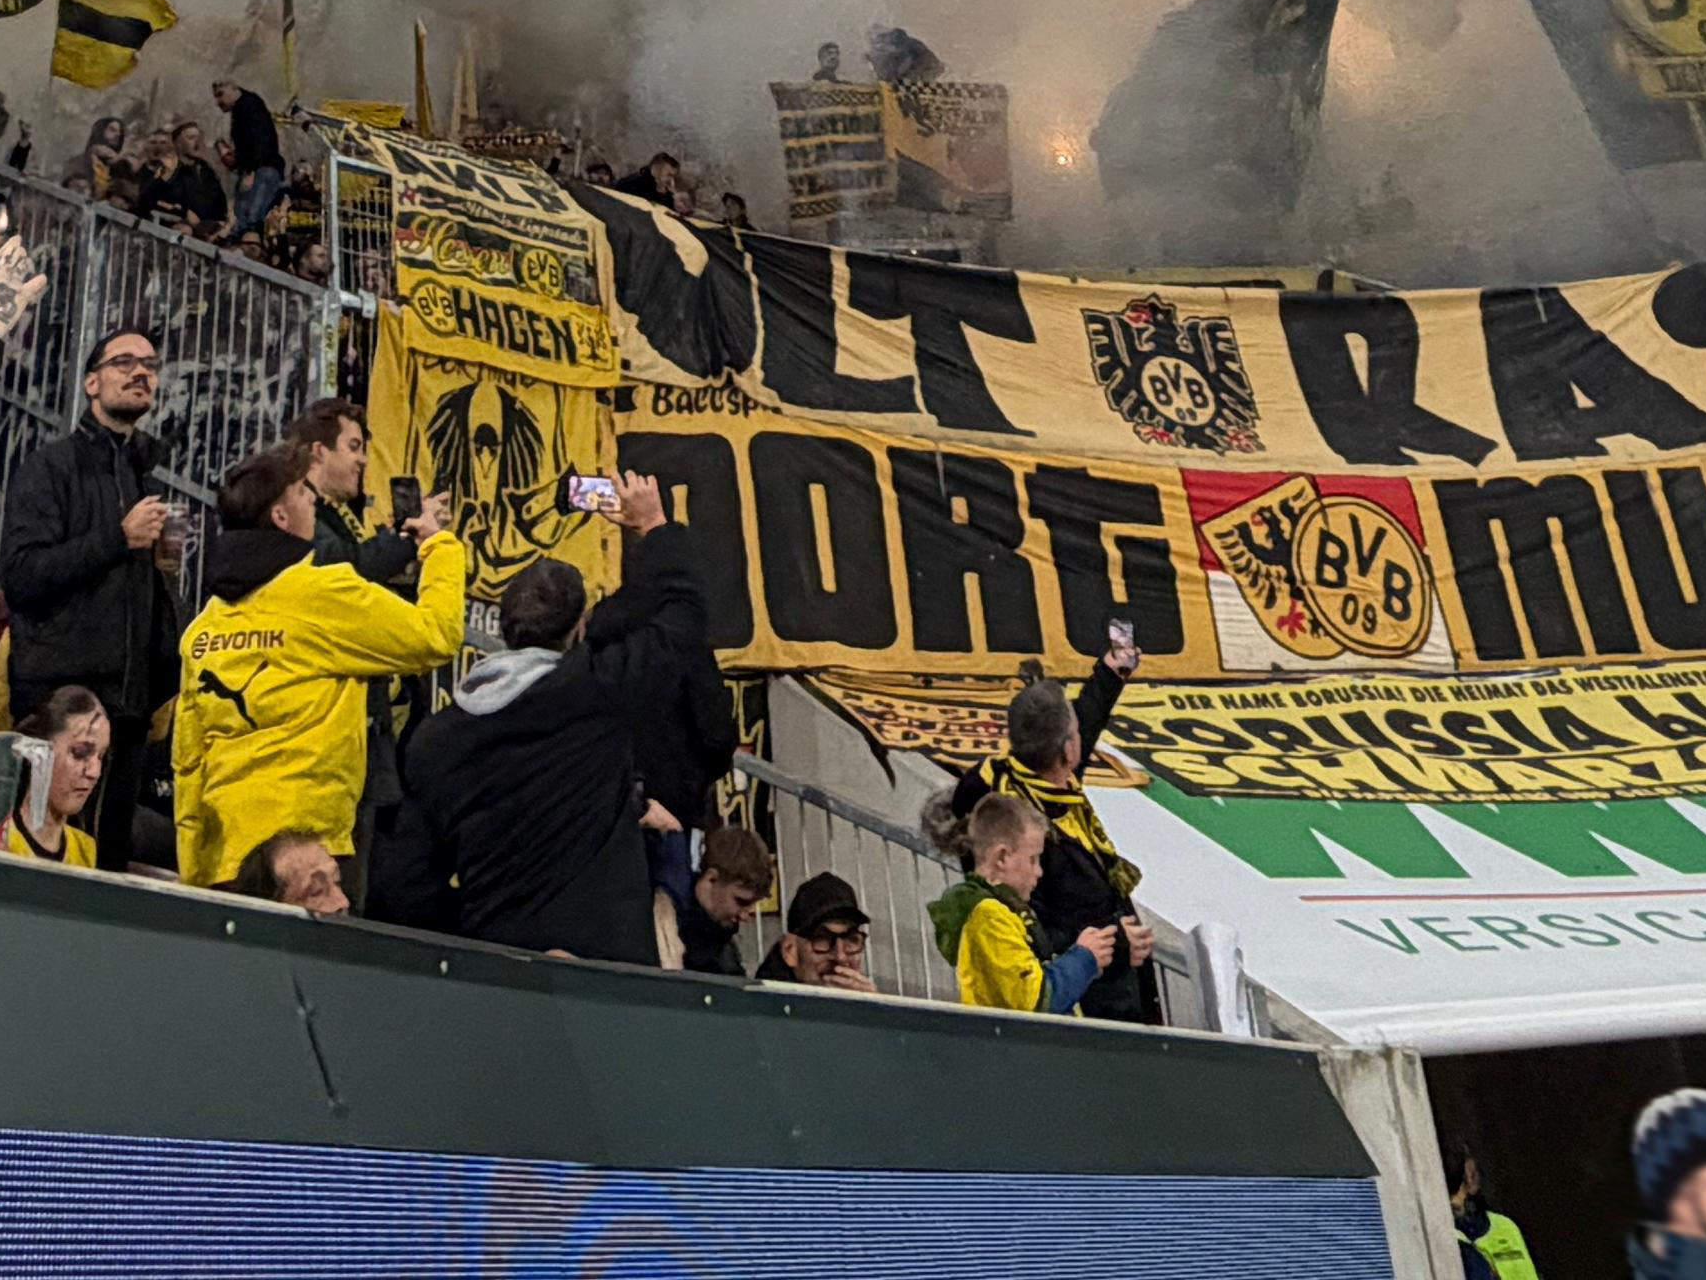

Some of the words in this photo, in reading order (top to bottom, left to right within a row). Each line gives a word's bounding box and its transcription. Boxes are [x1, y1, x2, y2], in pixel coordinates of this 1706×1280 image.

[418, 287, 454, 318] BVB
[451, 287, 578, 365] HAGEN
[1147, 360, 1211, 409] BVB
[1314, 512, 1414, 622] BVB
[1340, 592, 1379, 635] 09
[208, 629, 285, 654] EVONIK
[1168, 693, 1212, 712] DER
[1218, 690, 1286, 711] NAME
[1293, 686, 1407, 708] BORUSSIA!
[1409, 684, 1447, 704] DIE
[1454, 681, 1529, 703] HEIMAT
[1533, 678, 1575, 698] DAS
[1105, 703, 1633, 758] BORUSSIA
